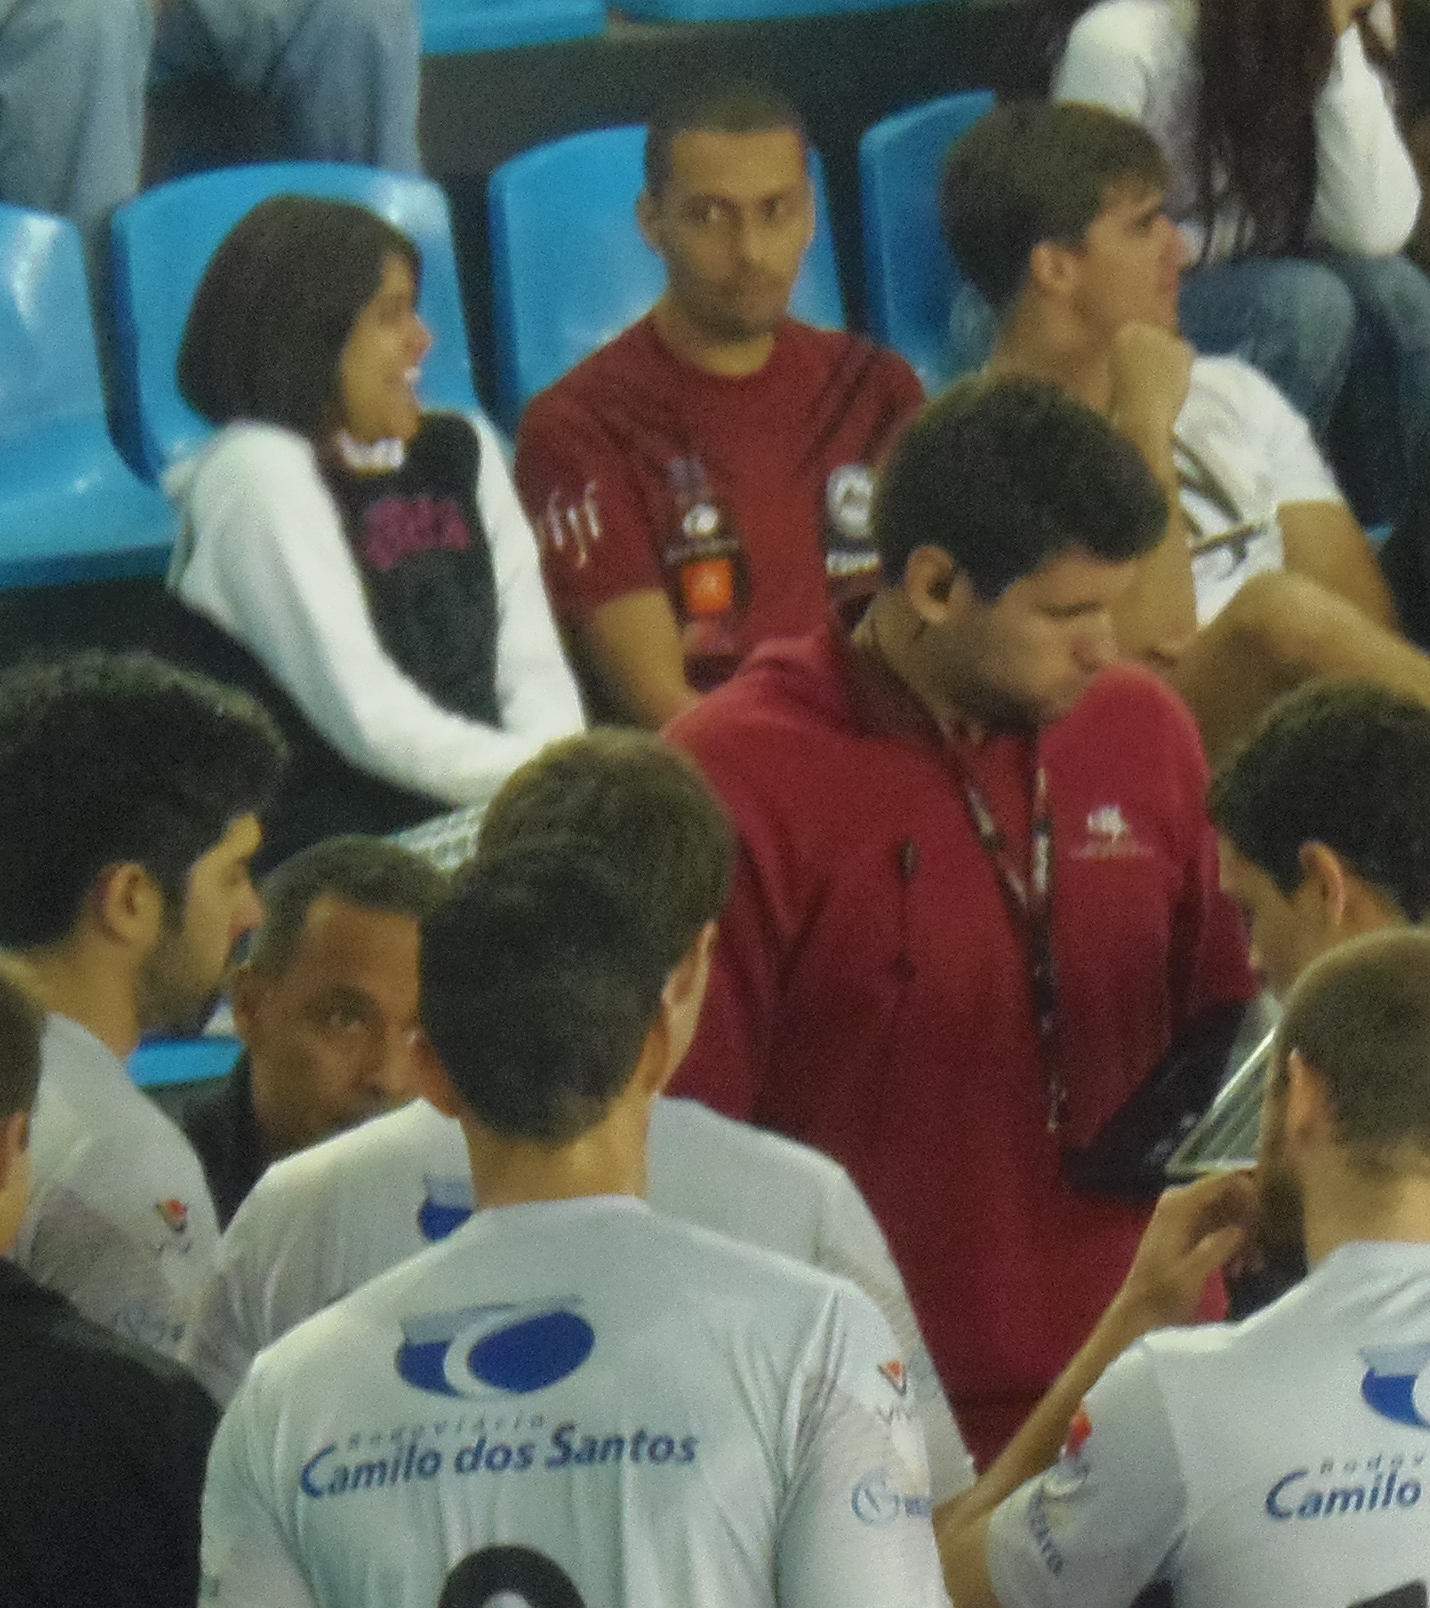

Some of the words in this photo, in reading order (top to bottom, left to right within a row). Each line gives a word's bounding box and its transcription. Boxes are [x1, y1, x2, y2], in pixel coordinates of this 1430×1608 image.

[300, 1439, 444, 1498] Camilo
[453, 1434, 536, 1474] dos
[547, 1422, 699, 1470] Santos
[1266, 1467, 1422, 1519] Camilo
